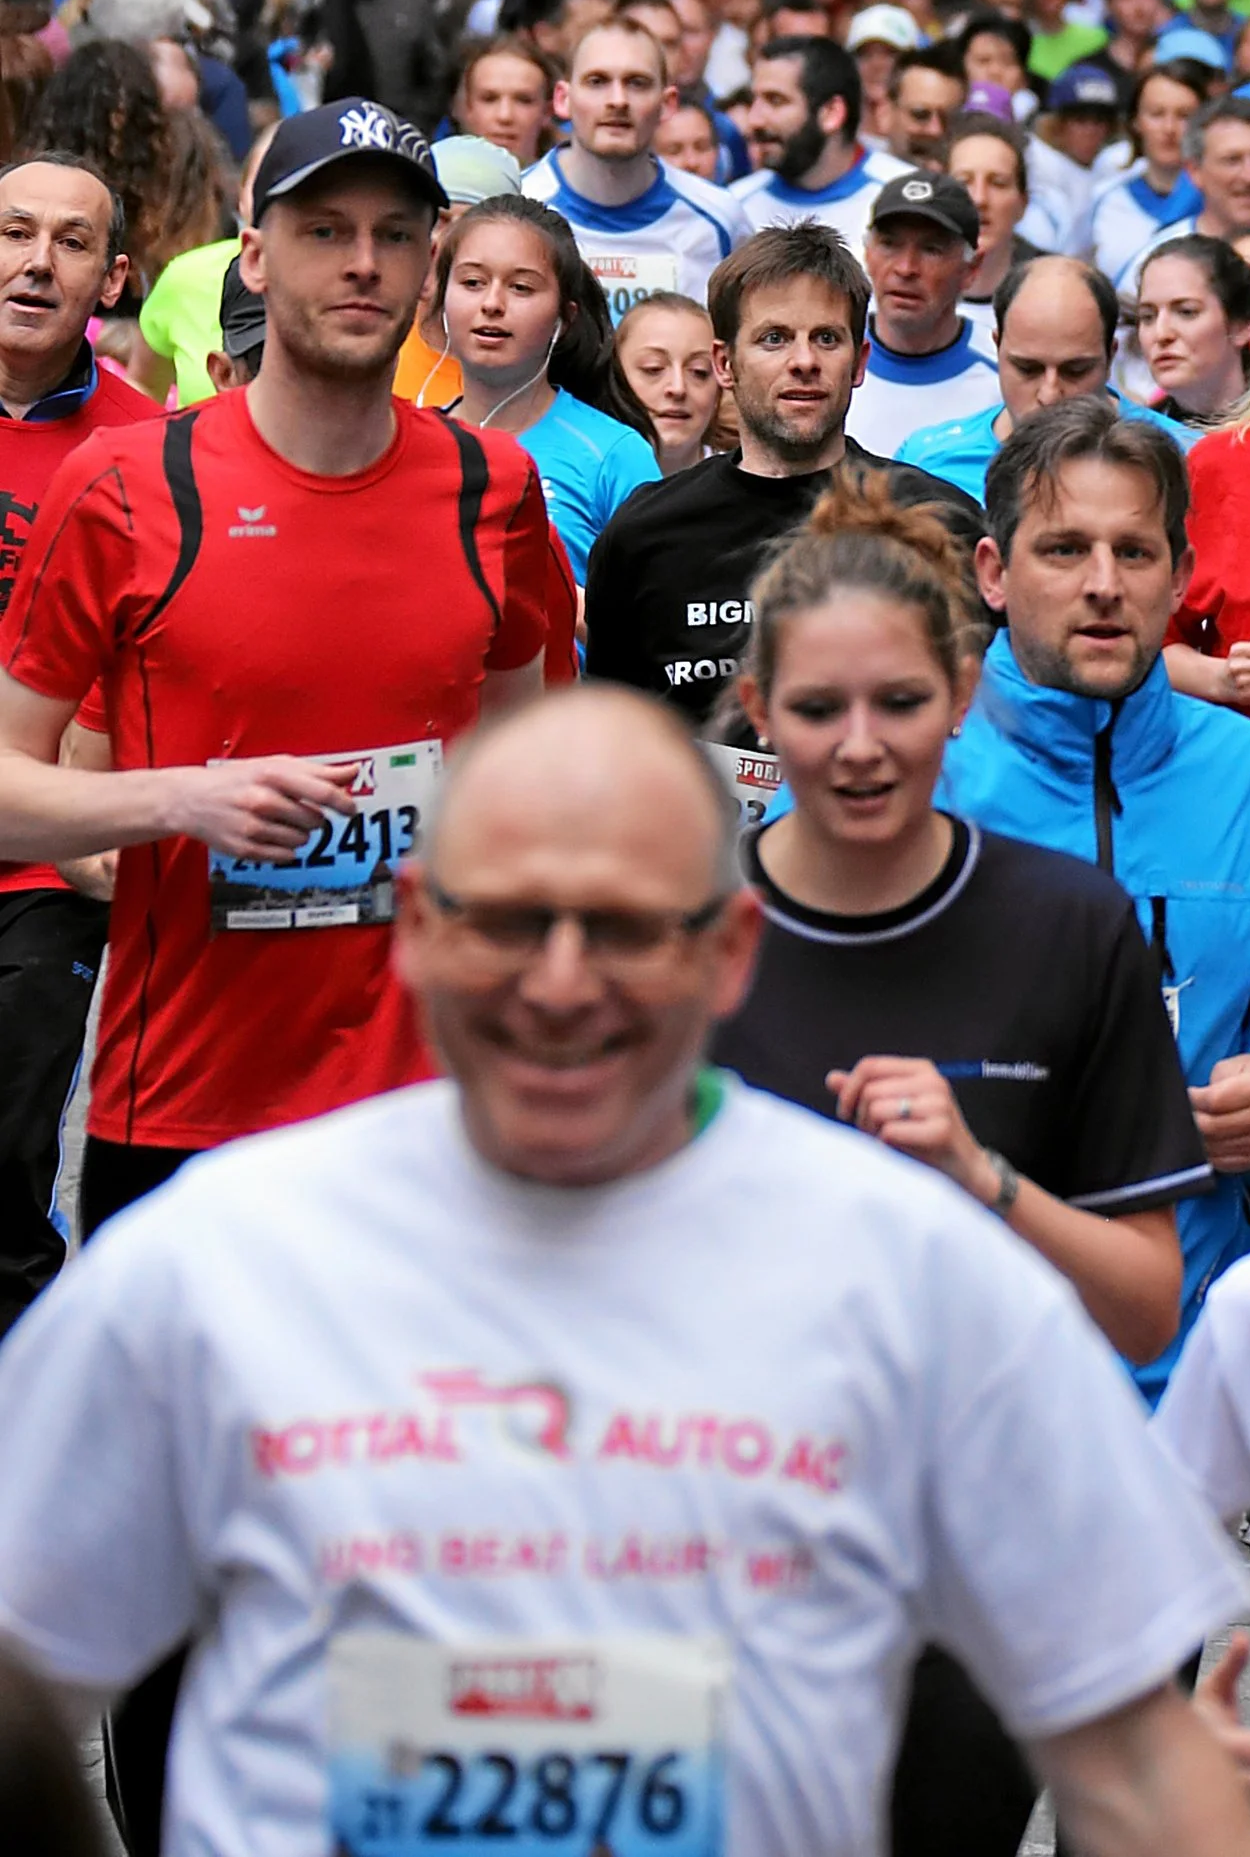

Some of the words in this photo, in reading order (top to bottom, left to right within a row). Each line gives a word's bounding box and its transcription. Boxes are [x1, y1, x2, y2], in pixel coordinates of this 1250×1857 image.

[228, 525, 276, 538] erima
[273, 805, 420, 870] 2413
[423, 1750, 688, 1842] 22876
